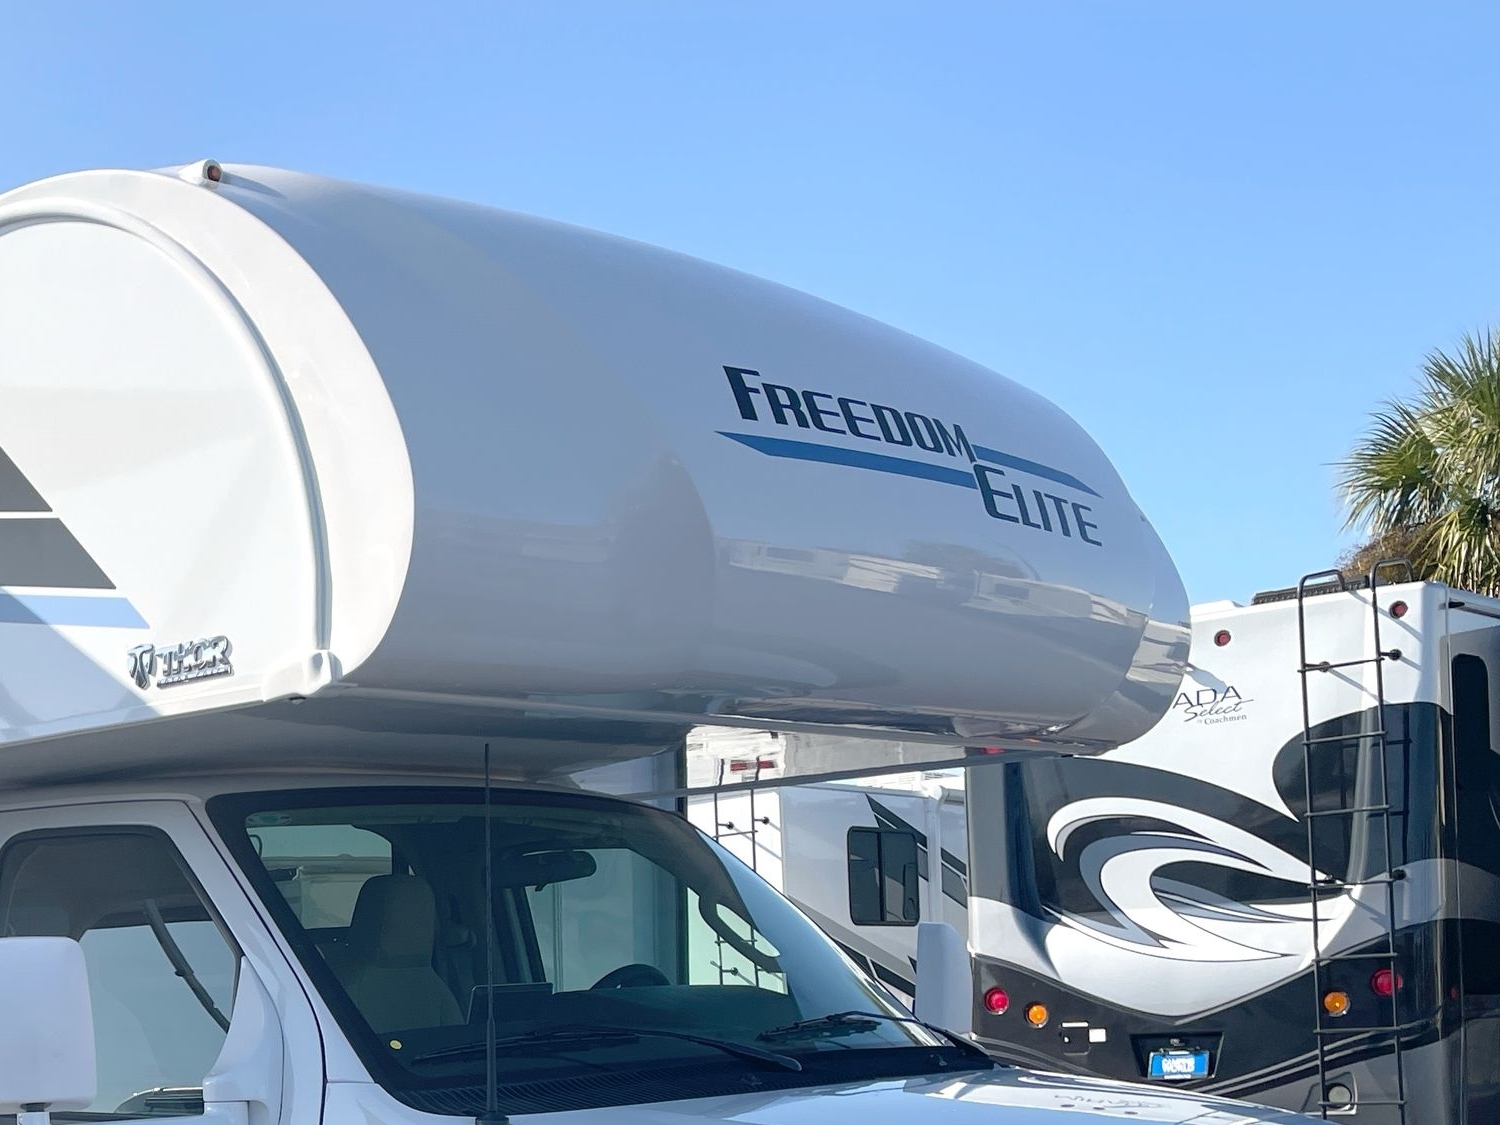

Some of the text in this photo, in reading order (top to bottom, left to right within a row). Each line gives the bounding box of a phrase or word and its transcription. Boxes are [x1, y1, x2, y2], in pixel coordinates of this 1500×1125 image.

[722, 365, 977, 464] FREEDOM
[972, 462, 1103, 547] ELITE
[1183, 699, 1254, 722] Select
[1204, 714, 1247, 725] Coachmen
